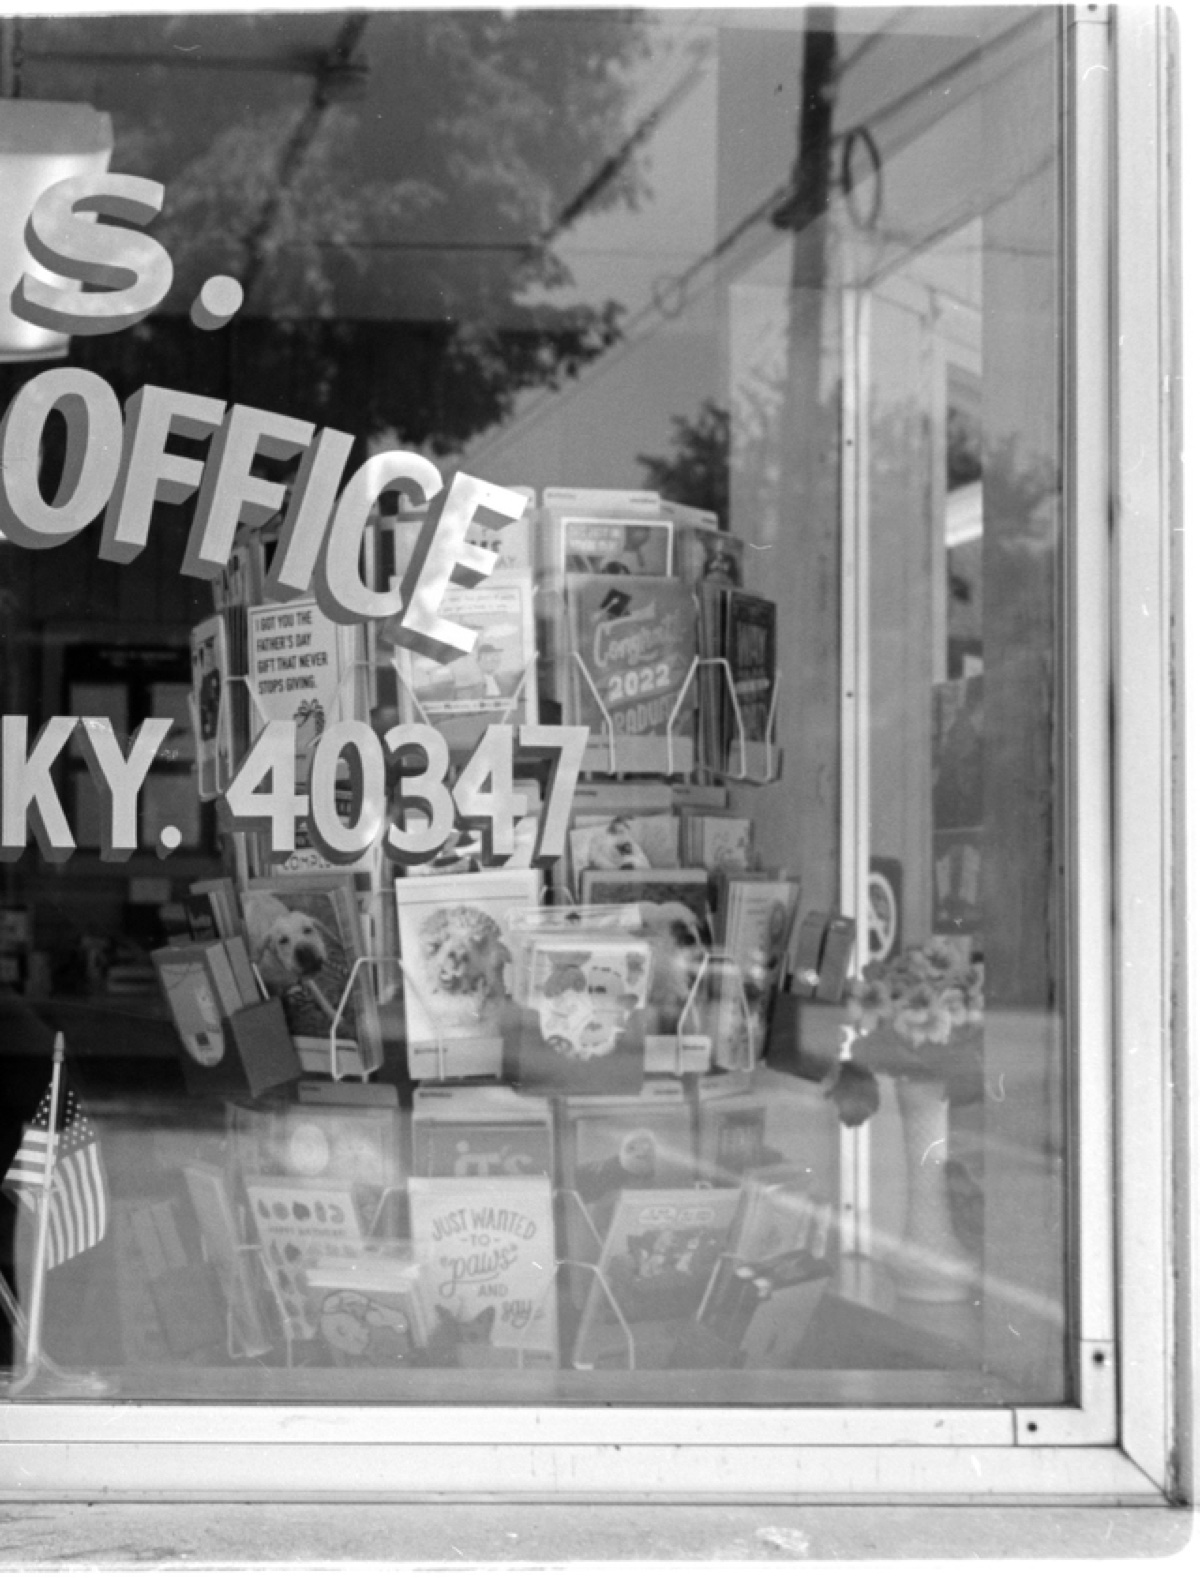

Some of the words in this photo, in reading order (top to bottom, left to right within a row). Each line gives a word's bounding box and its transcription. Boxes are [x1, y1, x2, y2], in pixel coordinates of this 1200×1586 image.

[260, 616, 276, 632] GOT
[277, 613, 295, 629] YOU
[296, 610, 312, 625] THE
[256, 634, 294, 652] FATHER'S
[295, 633, 312, 648] DAY
[257, 657, 275, 674] GIFT
[277, 655, 297, 672] THAT
[298, 651, 328, 669] NEVER
[258, 678, 284, 695] STOPS
[608, 663, 670, 701] 2022
[219, 718, 591, 869] 40347
[432, 1207, 467, 1241] JUST
[470, 1206, 537, 1240] WANTED
[477, 1283, 509, 1298] AND
